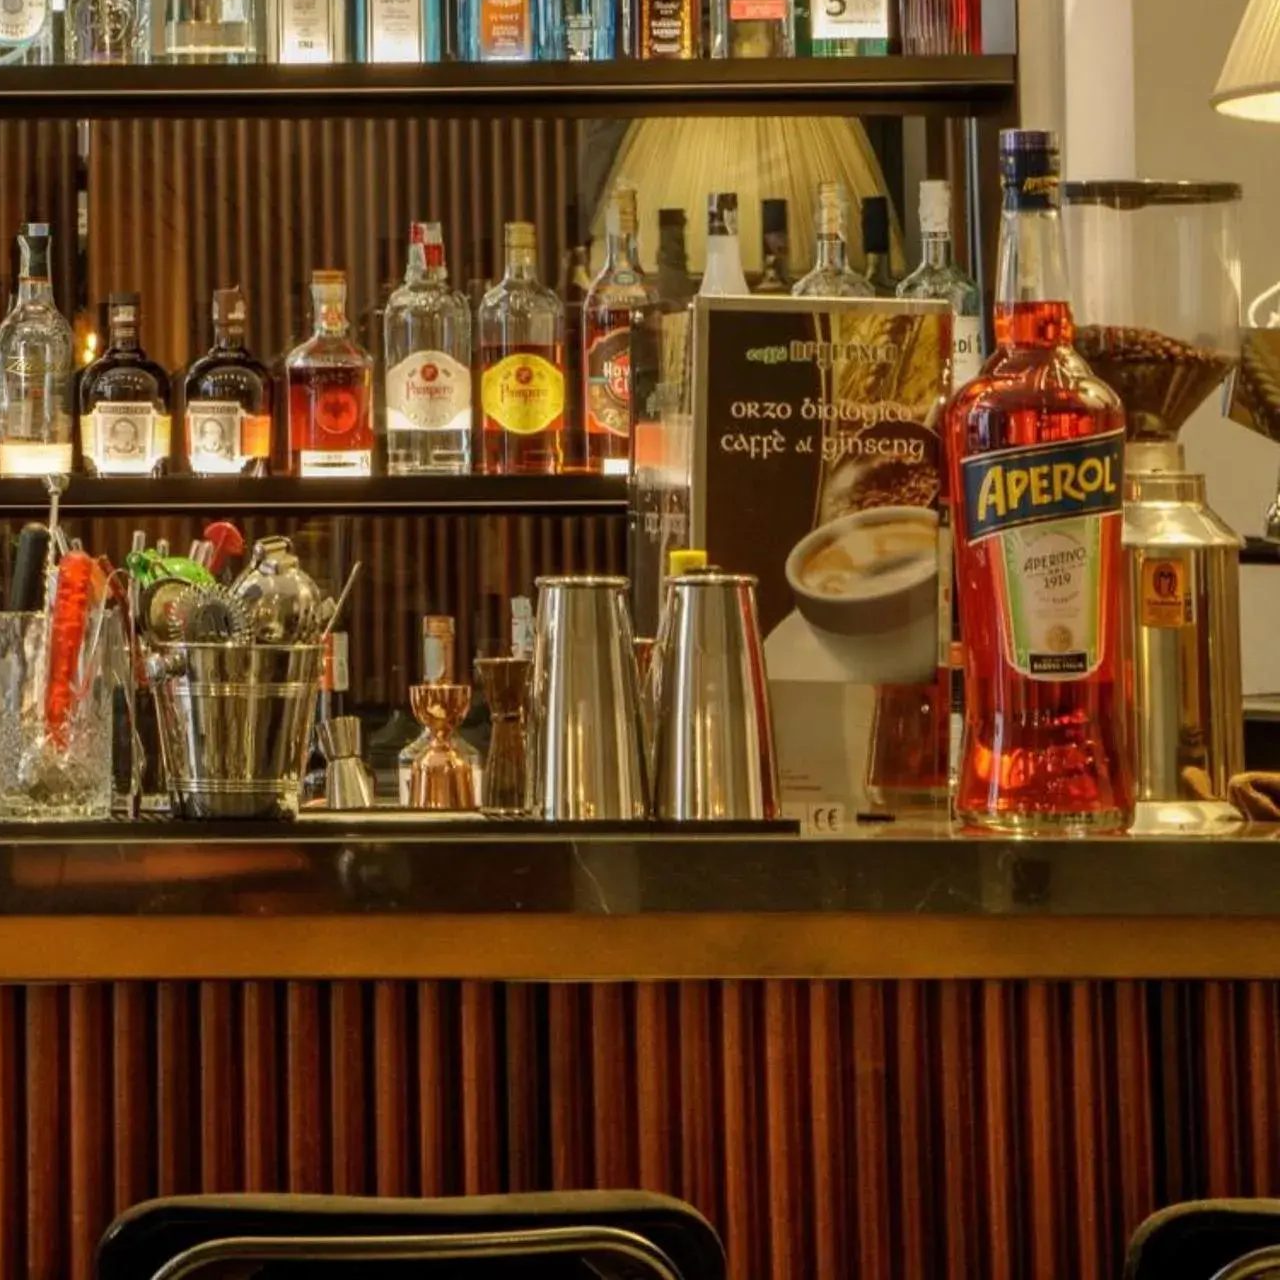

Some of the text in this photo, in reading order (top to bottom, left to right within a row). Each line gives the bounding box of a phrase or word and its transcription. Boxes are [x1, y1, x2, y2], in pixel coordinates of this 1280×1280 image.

[801, 397, 913, 428] biologico
[822, 429, 925, 463] ginseng
[978, 457, 1117, 522] APEROL
[1023, 547, 1086, 572] APERITIVO
[1044, 573, 1071, 589] 1919
